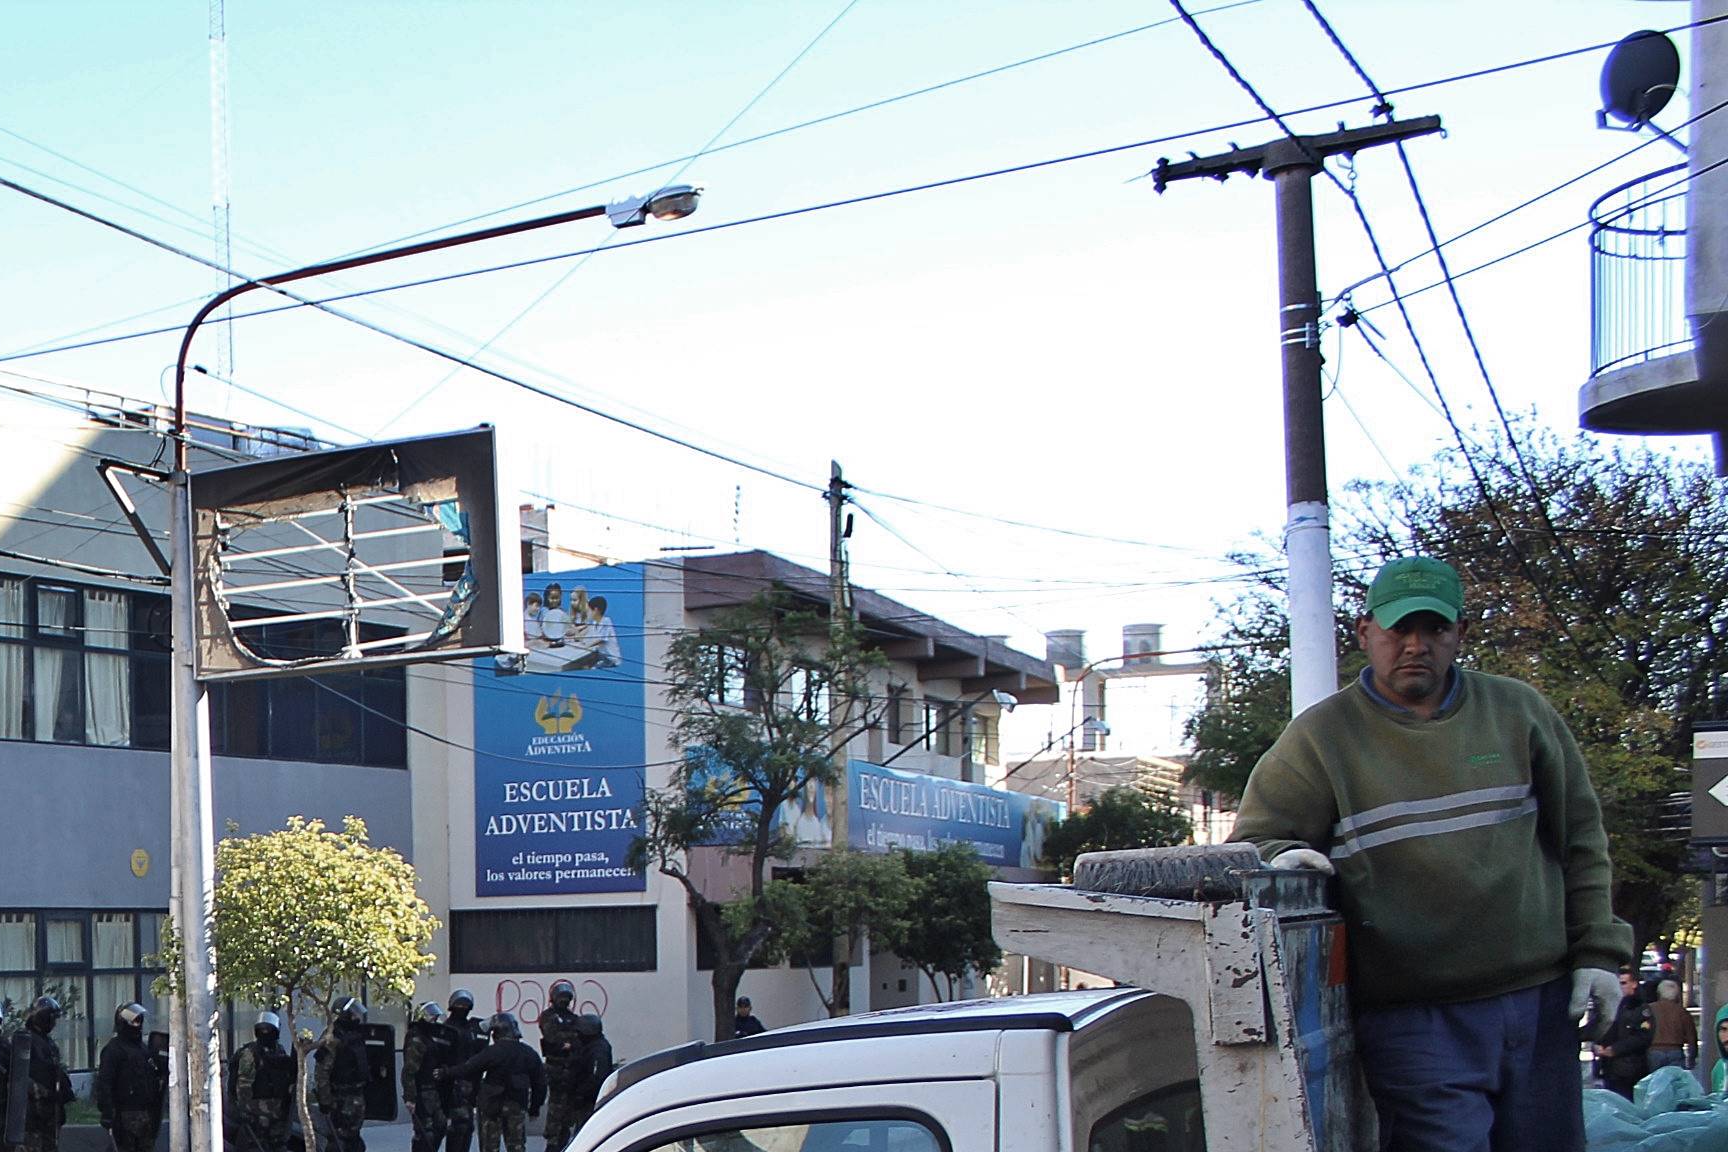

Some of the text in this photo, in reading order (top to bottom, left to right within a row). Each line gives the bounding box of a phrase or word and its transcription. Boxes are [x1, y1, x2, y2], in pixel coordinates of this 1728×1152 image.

[532, 732, 585, 745] EDUCACIÓN
[525, 741, 592, 756] ADVENTISTA
[503, 776, 612, 803] ESCUELA
[859, 774, 1012, 829] ESCUELA ADVENTISTA
[484, 808, 637, 836] ADVENTISTA
[512, 851, 609, 867] el tiempo pasa,
[486, 869, 505, 882] los
[508, 868, 551, 881] valores
